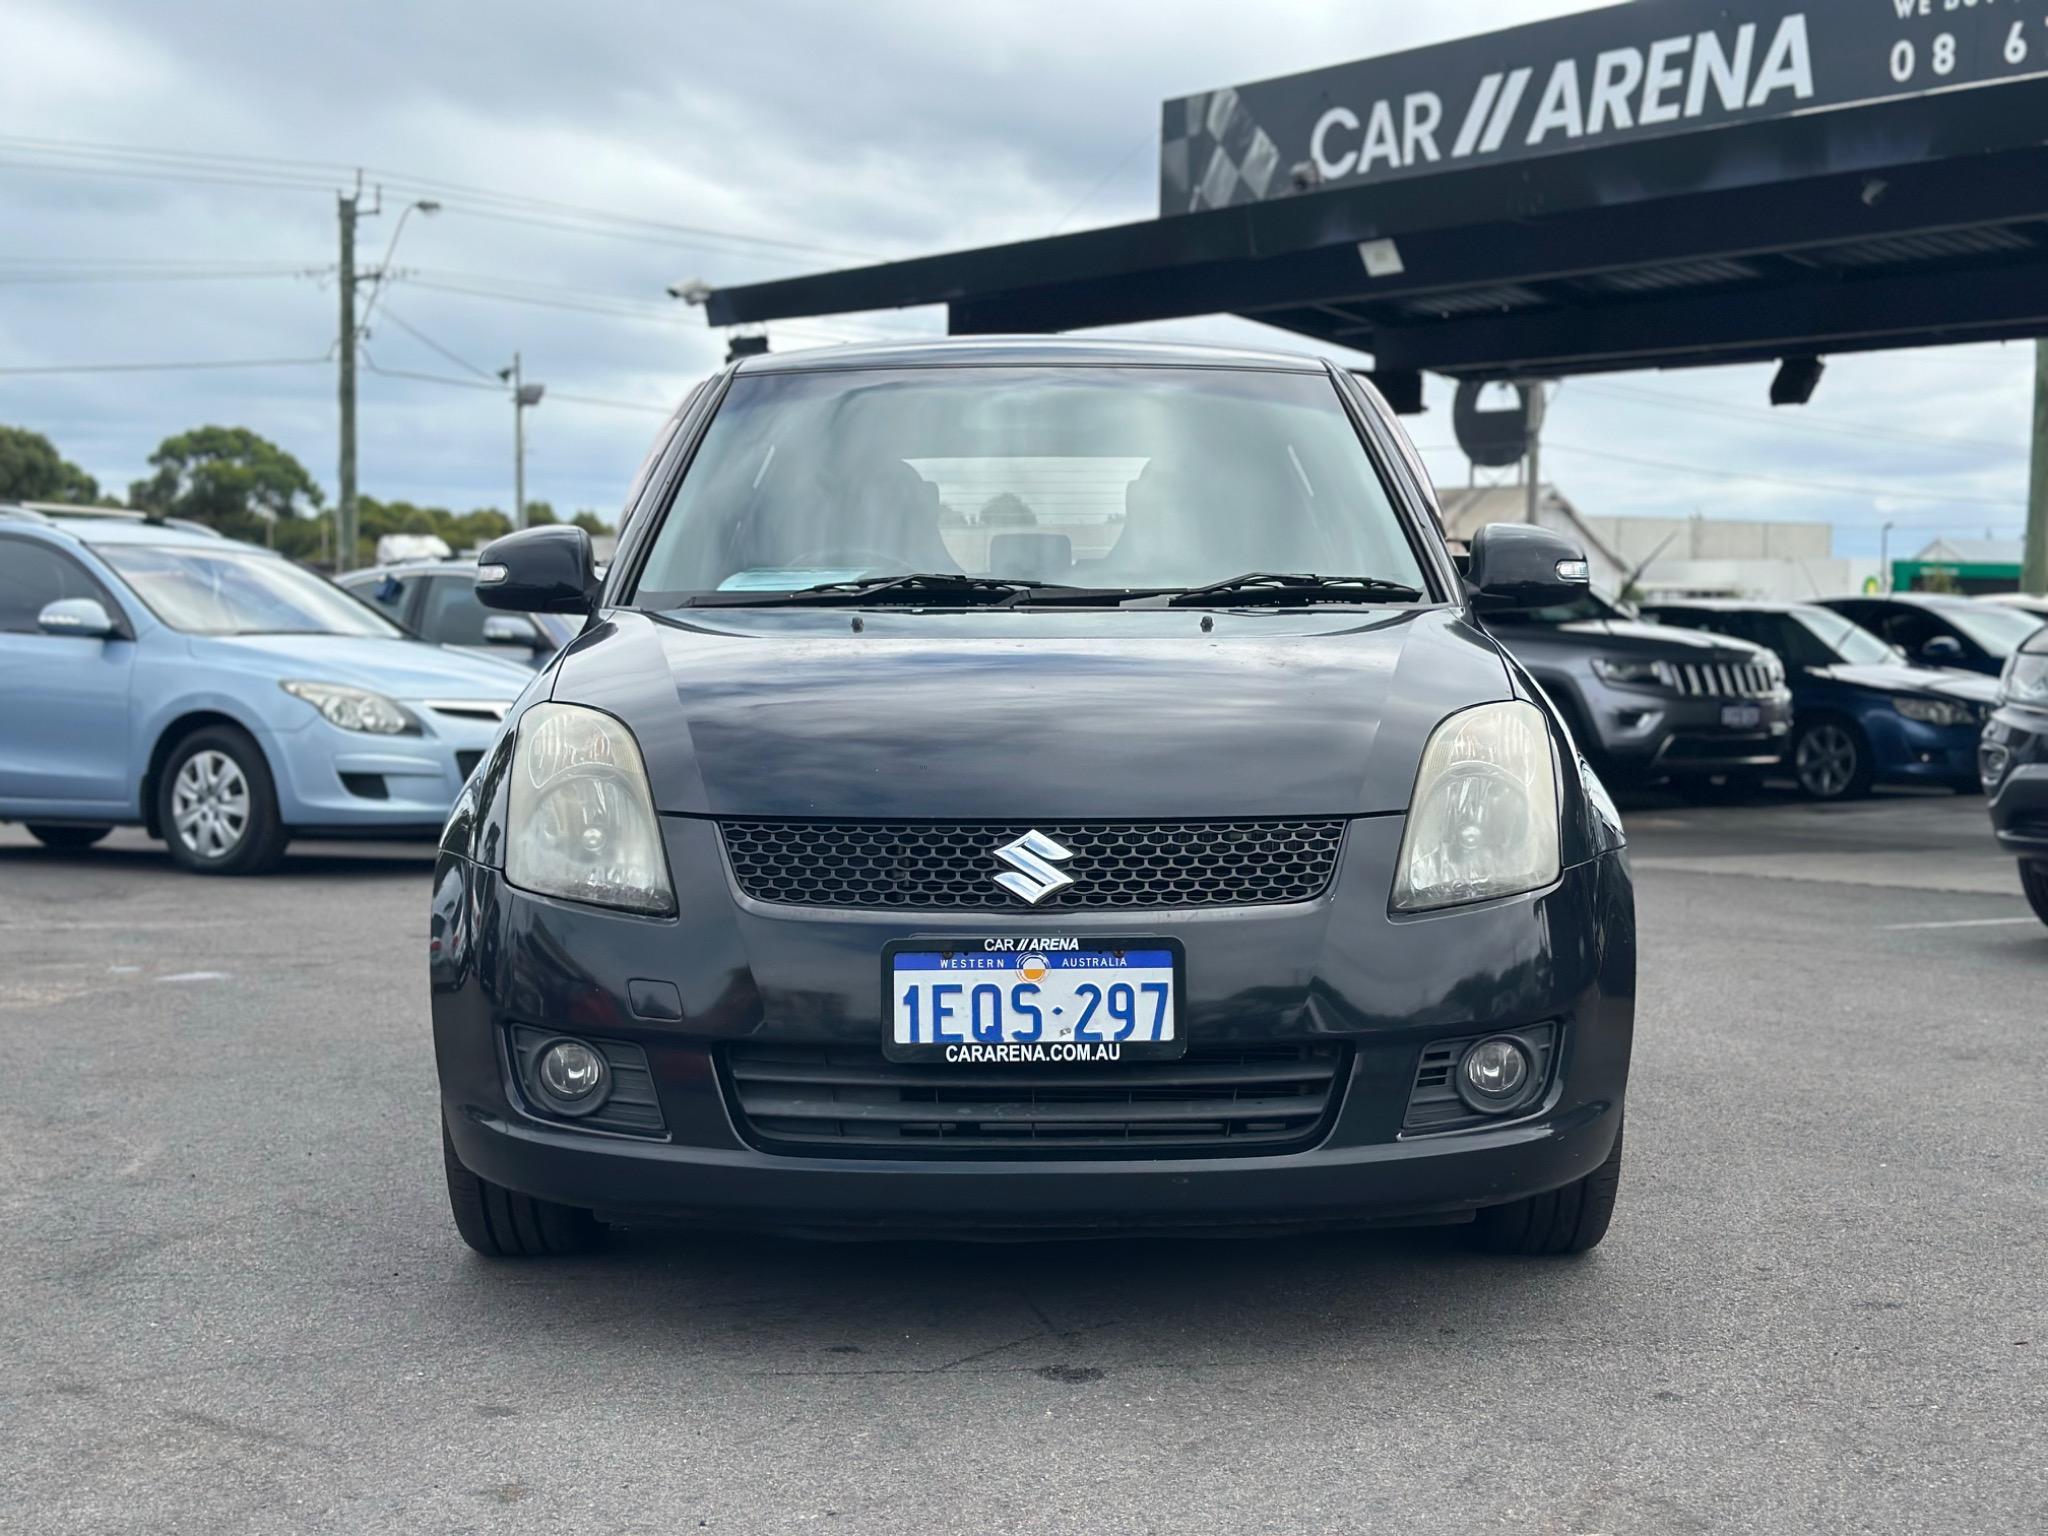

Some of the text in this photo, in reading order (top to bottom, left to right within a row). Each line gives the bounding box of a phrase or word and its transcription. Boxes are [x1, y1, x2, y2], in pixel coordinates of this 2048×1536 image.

[1311, 90, 1442, 179] CAR
[940, 957, 1127, 969] WESTERN AUSTRALIA
[945, 1043, 1121, 1063] CARARENA.COM.AU
